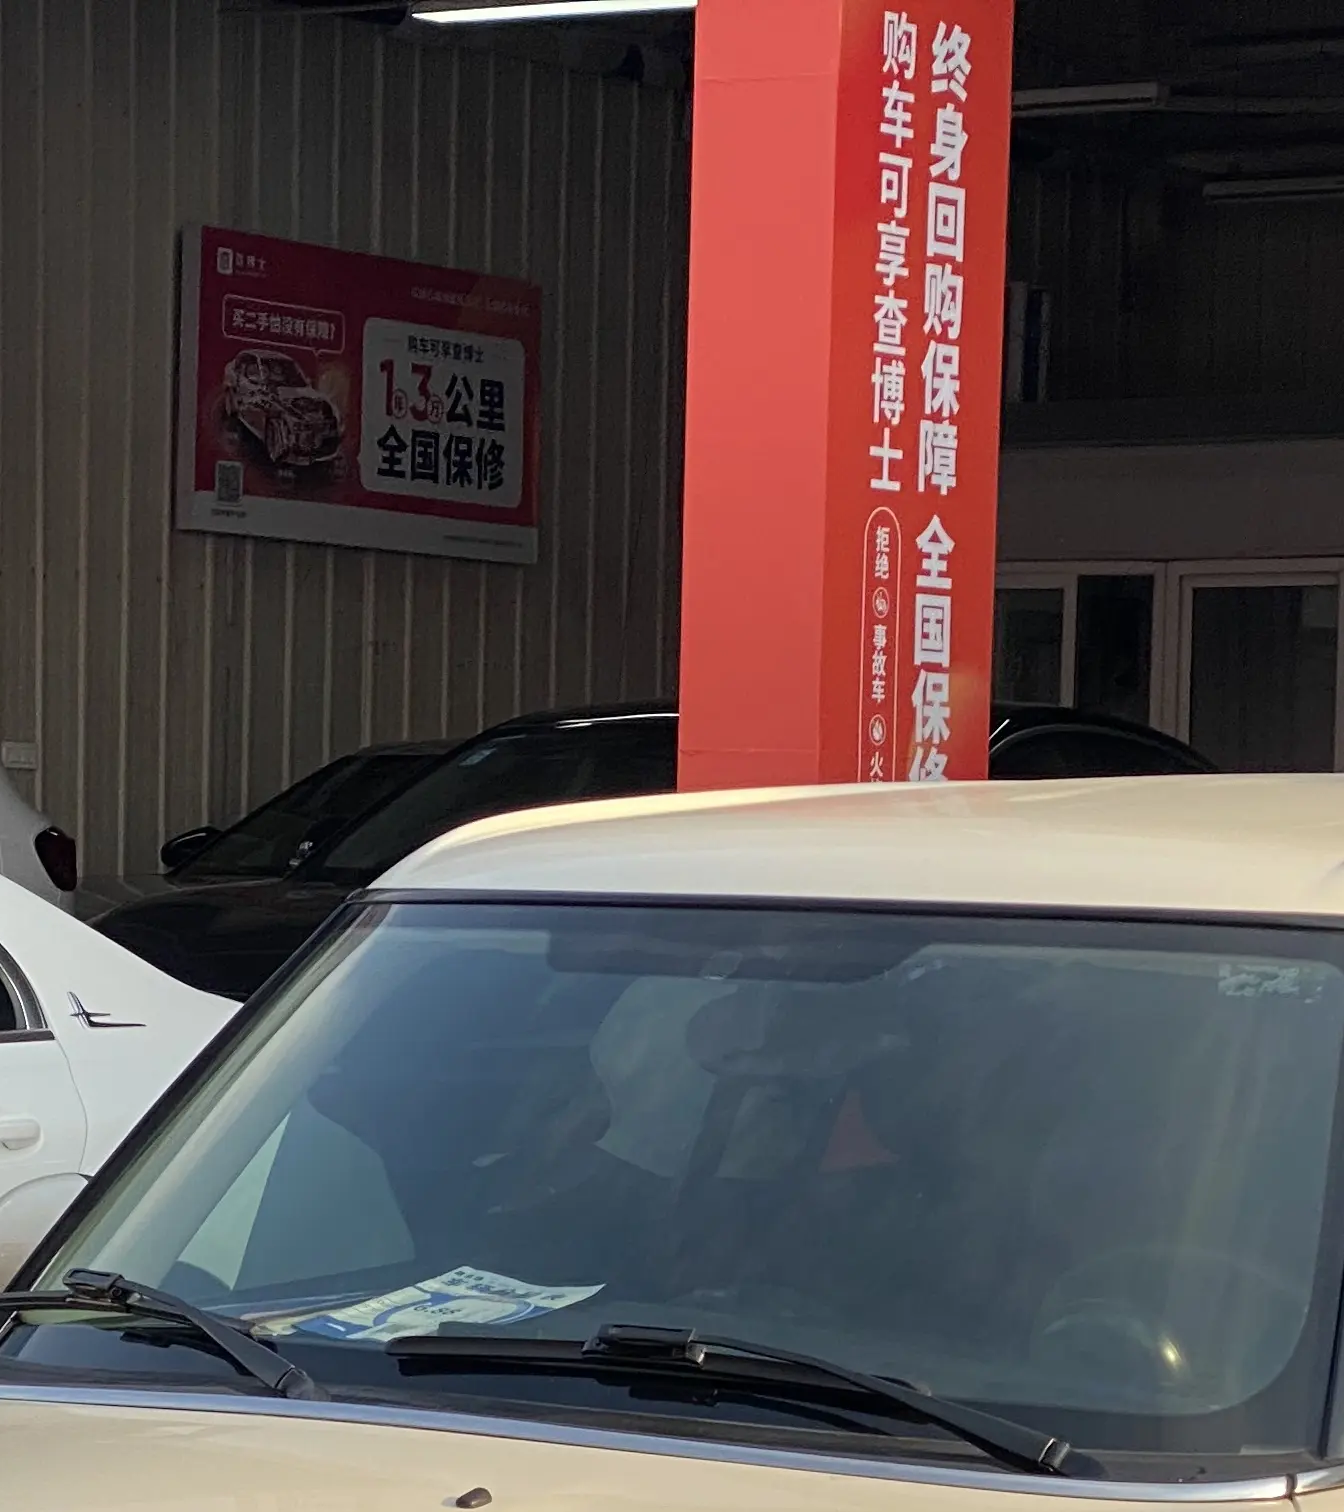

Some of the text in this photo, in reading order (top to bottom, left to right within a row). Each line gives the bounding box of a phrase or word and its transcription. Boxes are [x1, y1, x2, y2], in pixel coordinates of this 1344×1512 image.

[869, 11, 918, 492] 购车可享查博士
[918, 20, 971, 496] 终身回购保障
[376, 424, 505, 491] 全国保修
[874, 525, 890, 580] 拒绝
[871, 624, 888, 704] 事故车
